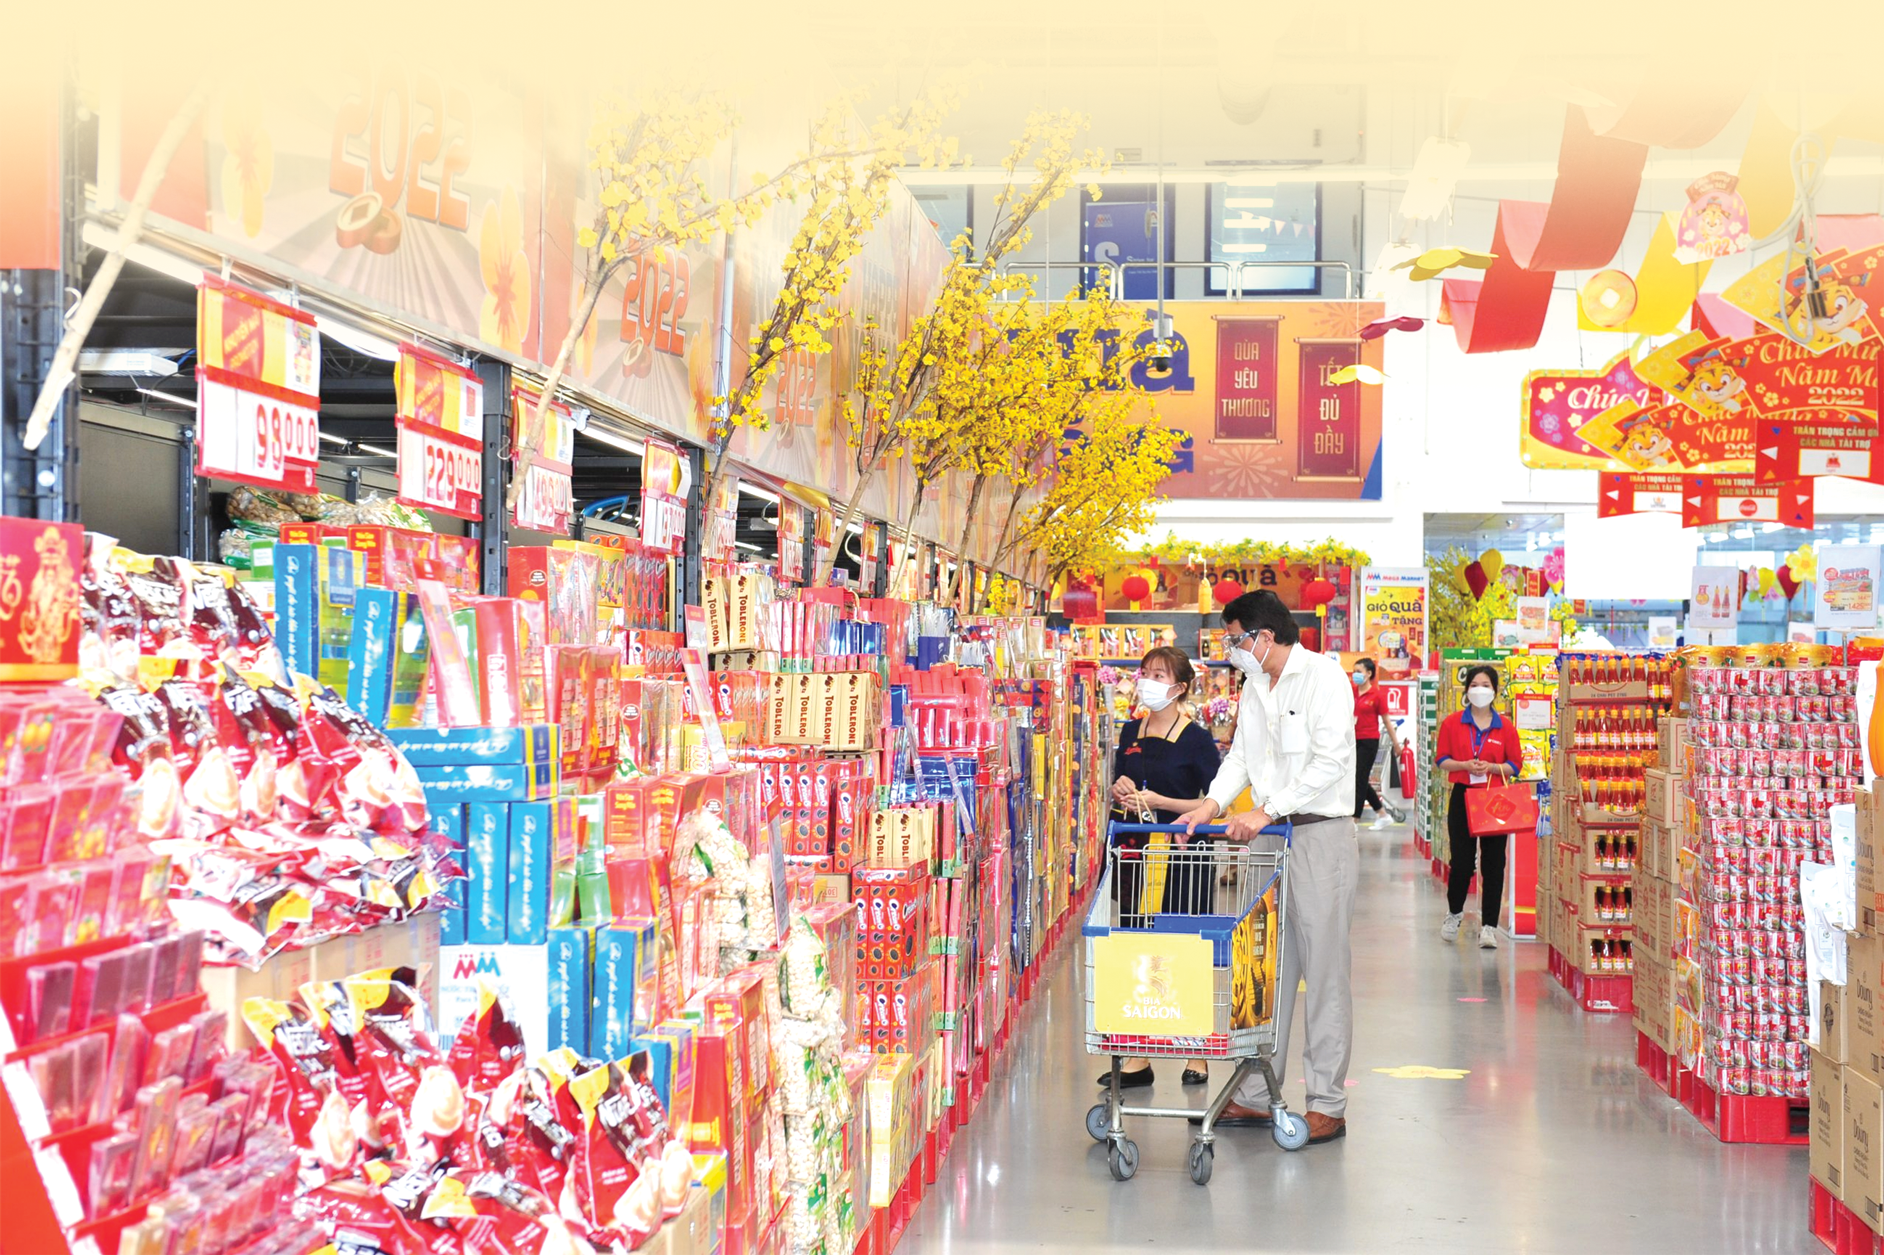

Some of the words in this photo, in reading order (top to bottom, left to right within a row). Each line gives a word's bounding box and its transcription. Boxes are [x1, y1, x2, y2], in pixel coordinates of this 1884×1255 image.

[329, 68, 471, 233] 2022
[620, 232, 690, 358] 2022
[775, 346, 817, 427] 2022
[1234, 366, 1258, 389] YÊU
[1775, 362, 1841, 388] Năm
[1221, 397, 1270, 418] THƯƠNG
[1319, 394, 1340, 421] ĐỦ
[1808, 386, 1865, 406] 2022
[256, 403, 317, 472] 98000
[1314, 425, 1344, 455] ĐẦY
[1695, 422, 1749, 446] Năm
[1838, 437, 1853, 448] TÀI
[1723, 443, 1756, 459] 202
[426, 444, 480, 502] 229000
[738, 594, 749, 644] TOBLERONE
[774, 696, 785, 736] TOBLERO
[799, 696, 810, 737] TOBLERO
[848, 694, 859, 745] TOBLERONE
[1122, 1005, 1182, 1019] SAIGON
[1143, 996, 1161, 1005] BIA
